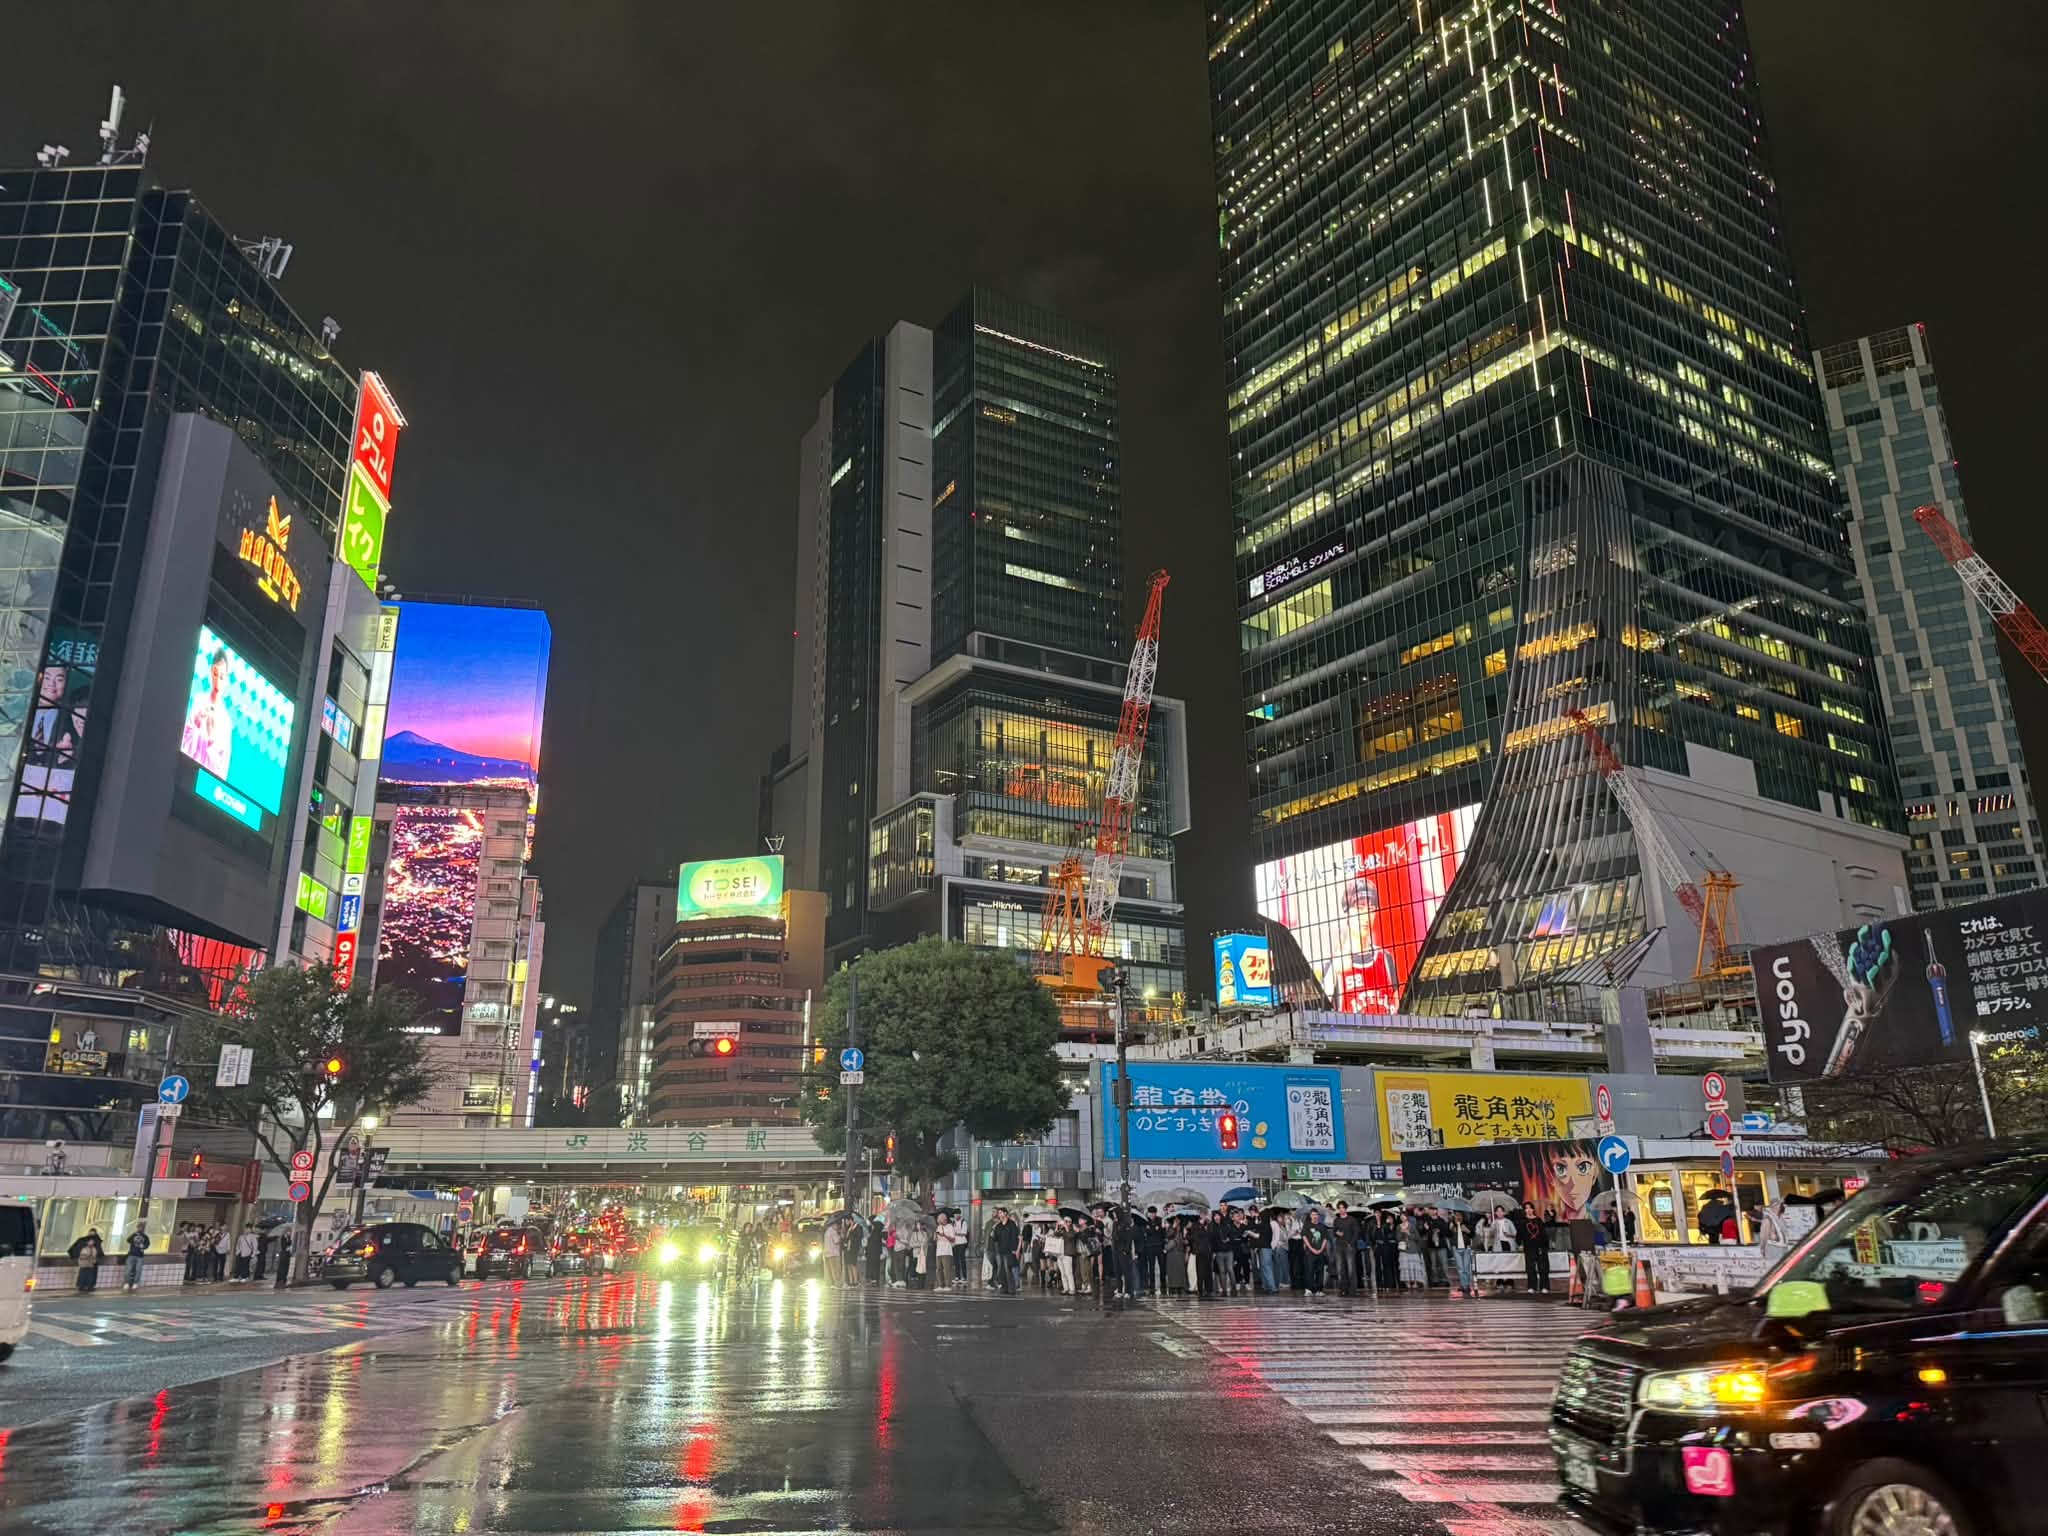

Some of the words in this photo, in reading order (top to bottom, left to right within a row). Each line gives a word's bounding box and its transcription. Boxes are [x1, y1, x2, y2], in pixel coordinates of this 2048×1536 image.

[361, 426, 387, 486] アコム
[348, 481, 375, 561] レイク
[239, 527, 301, 612] MAGNET
[1265, 563, 1308, 590] SCRAMBLE
[1309, 543, 1345, 568] SQUARE
[1265, 556, 1300, 580] SHIBUYA
[301, 880, 325, 907] レイク
[704, 876, 757, 891] TOSEI
[992, 900, 1022, 911] Hikarie
[1960, 916, 2003, 934] これは、
[1963, 926, 2033, 950] カメラで見て
[1967, 942, 2042, 967] 歯間を捉えて
[1970, 957, 2048, 983] 水流でフロス
[1773, 957, 1811, 1065] dyson
[1976, 996, 2031, 1016] 歯ブラシ。
[1134, 1086, 1249, 1116] 龍角散の
[1136, 1116, 1251, 1132] のどすっき飴
[1312, 1090, 1332, 1146] 龍角散の
[566, 1134, 588, 1147] JR
[627, 1129, 767, 1152] 渋谷駅
